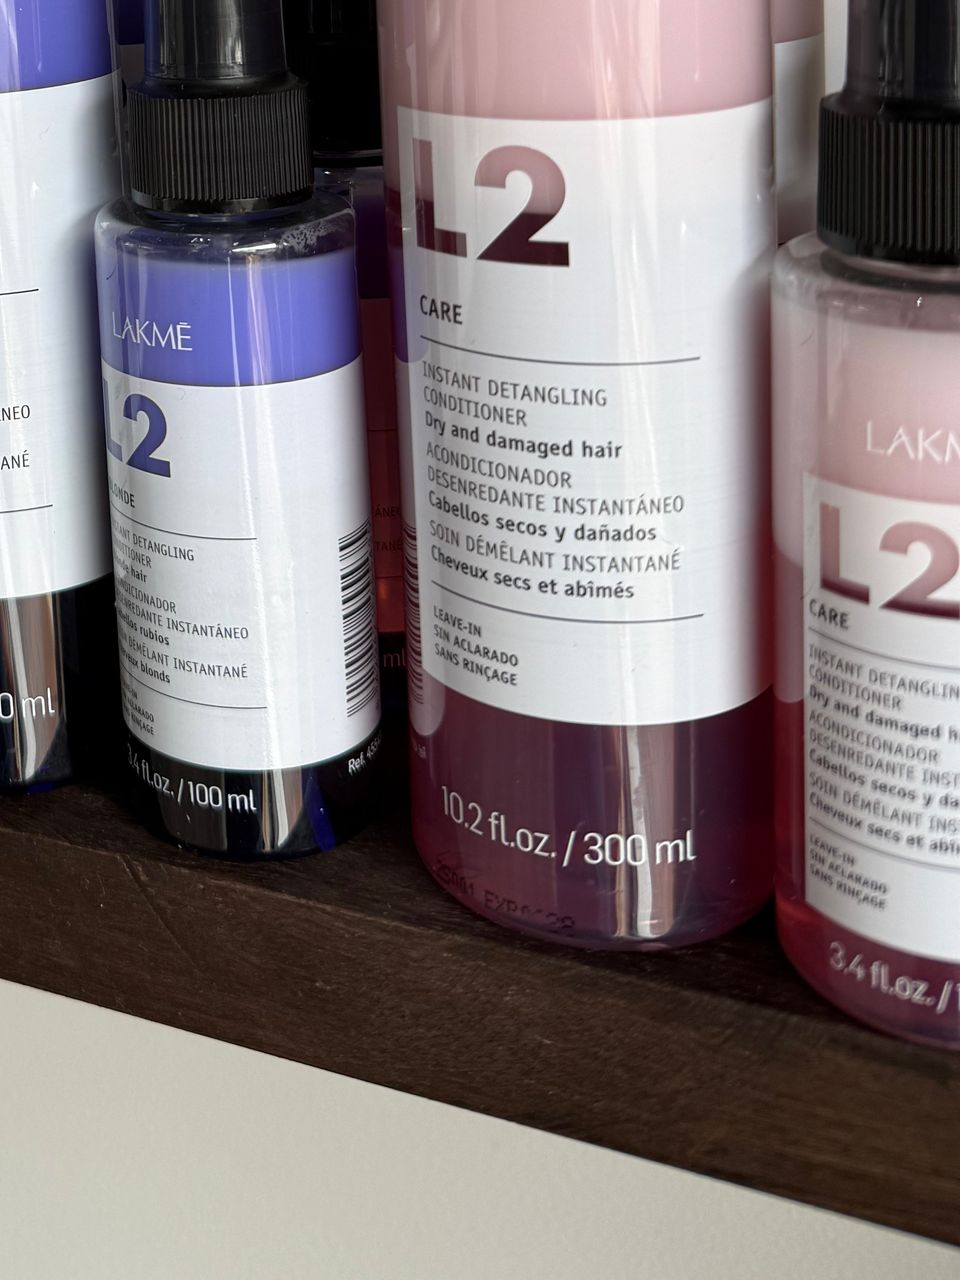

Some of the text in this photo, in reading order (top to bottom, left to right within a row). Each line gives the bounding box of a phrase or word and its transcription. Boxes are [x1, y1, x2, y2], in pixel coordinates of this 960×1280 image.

[412, 136, 570, 268] L2
[112, 311, 193, 352] LAKMĒ
[419, 295, 463, 325] CARE
[422, 360, 608, 407] INSTANT DETANGLING
[423, 385, 528, 427] CONDITIONER
[103, 377, 172, 479] L2
[425, 410, 623, 459] Dry and damaged hair
[426, 441, 573, 489] ACONDICIONADOR
[427, 464, 685, 518] DESENREDANTE INSTANTÁNEO
[428, 490, 490, 527] Cabellos
[495, 516, 548, 538] secos
[554, 526, 566, 543] y
[574, 523, 656, 542] dañados
[132, 533, 195, 562] DETANGLING
[429, 519, 460, 548] SOIN
[466, 534, 555, 570] DÉMÊLANT
[562, 548, 682, 574] INSTANTANÉ
[820, 502, 960, 621] L2
[130, 565, 148, 584] hair
[431, 544, 635, 599] Cheveux secs et abîmés
[139, 625, 171, 646] rubios
[166, 617, 249, 640] INSTANTÁNEO
[433, 605, 482, 638] LEAVE-IN
[809, 599, 850, 630] CARE
[173, 658, 248, 679] INSTANTANÉ
[433, 624, 519, 667] SIN ACLARADO
[434, 643, 518, 687] SANS RINÇAGE
[140, 662, 171, 684] blonds
[809, 644, 960, 704] INSTANT DETANGLIN
[809, 664, 902, 713] CONDITIONER
[22, 686, 56, 718] ml
[809, 684, 829, 708] Dry
[833, 700, 860, 719] and
[865, 709, 942, 740] damaged
[809, 709, 939, 763] ACONDICIONADOR
[809, 728, 915, 780] DESENREDANTE
[141, 758, 176, 799] fl.oz.
[187, 780, 223, 809] 100
[228, 789, 256, 812] ml
[809, 748, 935, 807] Cabellos secos y
[809, 771, 838, 798] SOIN
[843, 787, 923, 828] DÉMÊLANT
[441, 785, 483, 837] 10.2
[489, 811, 558, 859] fl.oz.
[583, 832, 650, 869] 300
[655, 829, 697, 866] ml
[809, 790, 924, 848] Cheveux secs et
[829, 941, 865, 982] 3.4
[870, 960, 936, 1008] fl.oz.
